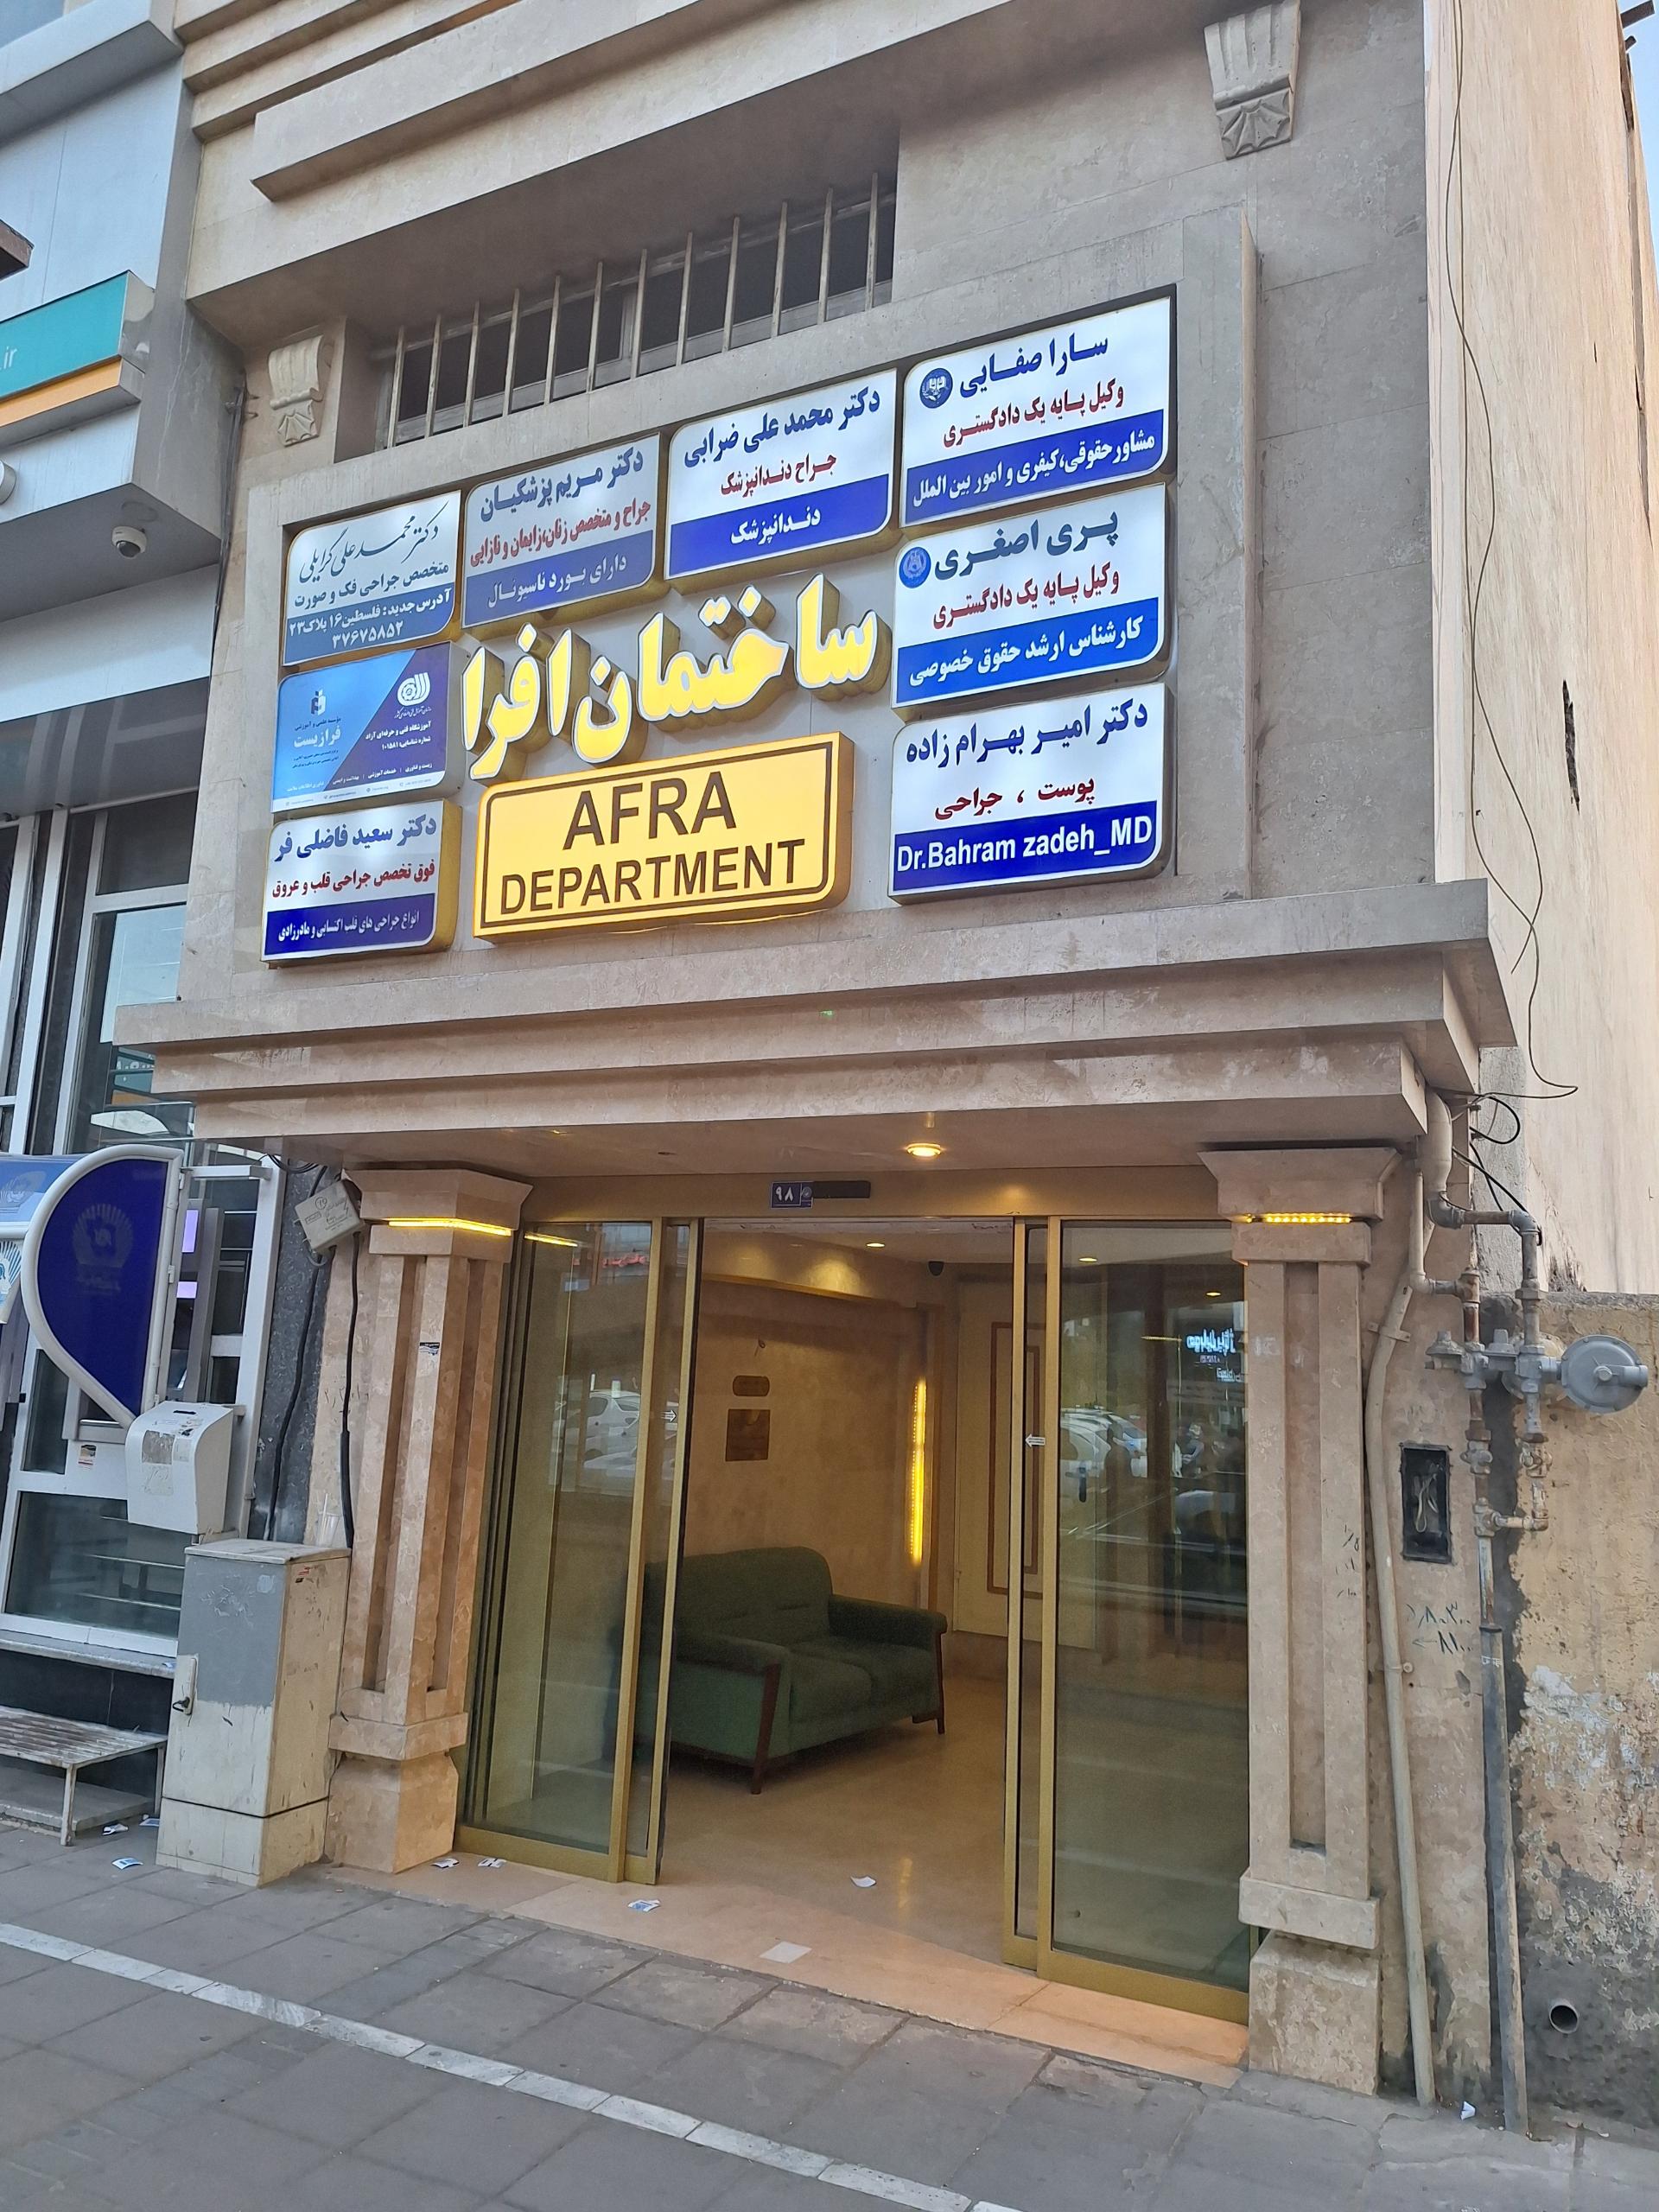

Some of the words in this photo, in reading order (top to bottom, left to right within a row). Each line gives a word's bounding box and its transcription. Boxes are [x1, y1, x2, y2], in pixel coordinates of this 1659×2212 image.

[1049, 332, 1109, 376] سارا
[959, 346, 1042, 399] صفایی
[837, 385, 880, 431] دکتر
[1023, 396, 1046, 423] یک
[1050, 389, 1085, 420] پایه
[1089, 378, 1124, 412] وکیل
[743, 412, 779, 454] علی
[784, 405, 834, 436] محمد
[943, 403, 1020, 448] دادگستری
[684, 423, 739, 468] ضرابی
[1112, 429, 1155, 463] مشاور
[607, 447, 644, 489] دکتر
[721, 460, 791, 498] دندانپزشک
[795, 453, 837, 483] جراح
[973, 461, 1002, 494] امور
[1005, 467, 1014, 486] و
[480, 476, 552, 522] پزشکیان
[556, 467, 603, 503] مریم
[912, 474, 946, 507] الملل
[949, 476, 972, 499] بین
[570, 508, 612, 542] متخصص
[613, 513, 620, 531] و
[623, 498, 652, 527] جراح
[730, 505, 821, 545] دندانپزشک
[401, 500, 449, 564] دکتر
[1046, 511, 1118, 556] پری
[470, 535, 500, 568] نازایی
[502, 541, 509, 560] و
[934, 519, 1039, 581] اصغری
[359, 573, 400, 596] جراحی
[404, 562, 448, 587] متخصص
[548, 566, 587, 594] بورد
[589, 553, 627, 584] دارای
[1084, 562, 1120, 599] وکیل
[295, 591, 327, 610] صورت
[329, 592, 335, 604] و
[339, 579, 357, 597] فک
[416, 588, 452, 613] آدرس
[487, 569, 546, 608] ناسیونال
[1016, 578, 1038, 609] یک
[1043, 572, 1079, 605] پایه
[932, 583, 1012, 629] دادگستری
[332, 620, 404, 649] ۳۷۶۷۵۸۵۲
[1025, 630, 1065, 662] ارشد
[1069, 615, 1144, 657] کارشناس
[571, 573, 878, 765] ساختمان
[909, 648, 974, 688] خصوصی
[977, 642, 1021, 674] حقوق
[461, 622, 573, 781] افرا
[294, 725, 341, 747] فرازیست
[1031, 704, 1091, 754] امیر
[1096, 697, 1148, 745] دکتر
[906, 728, 950, 768] زاده
[956, 722, 1025, 766] بهرام
[934, 787, 1003, 820] جراحی
[1038, 778, 1095, 804] پوست
[563, 771, 737, 851] AFRA
[296, 823, 348, 858] فاضلی
[353, 826, 393, 849] سعید
[397, 814, 436, 846] دکتر
[897, 837, 1015, 872] Dr.Bahram
[1023, 815, 1153, 856] zadeh_MD
[275, 831, 293, 862] فر
[310, 871, 331, 894] قلب
[333, 869, 372, 892] جراحی
[374, 863, 411, 887] تخصص
[414, 859, 435, 883] فوق
[500, 838, 805, 915] DEPARTMENT
[272, 880, 300, 899] عروق
[302, 881, 308, 895] و
[310, 927, 316, 939] و
[358, 916, 372, 934] های
[374, 913, 400, 932] جراحی
[400, 910, 420, 929] انواع
[776, 1186, 794, 1201] ۹۸
